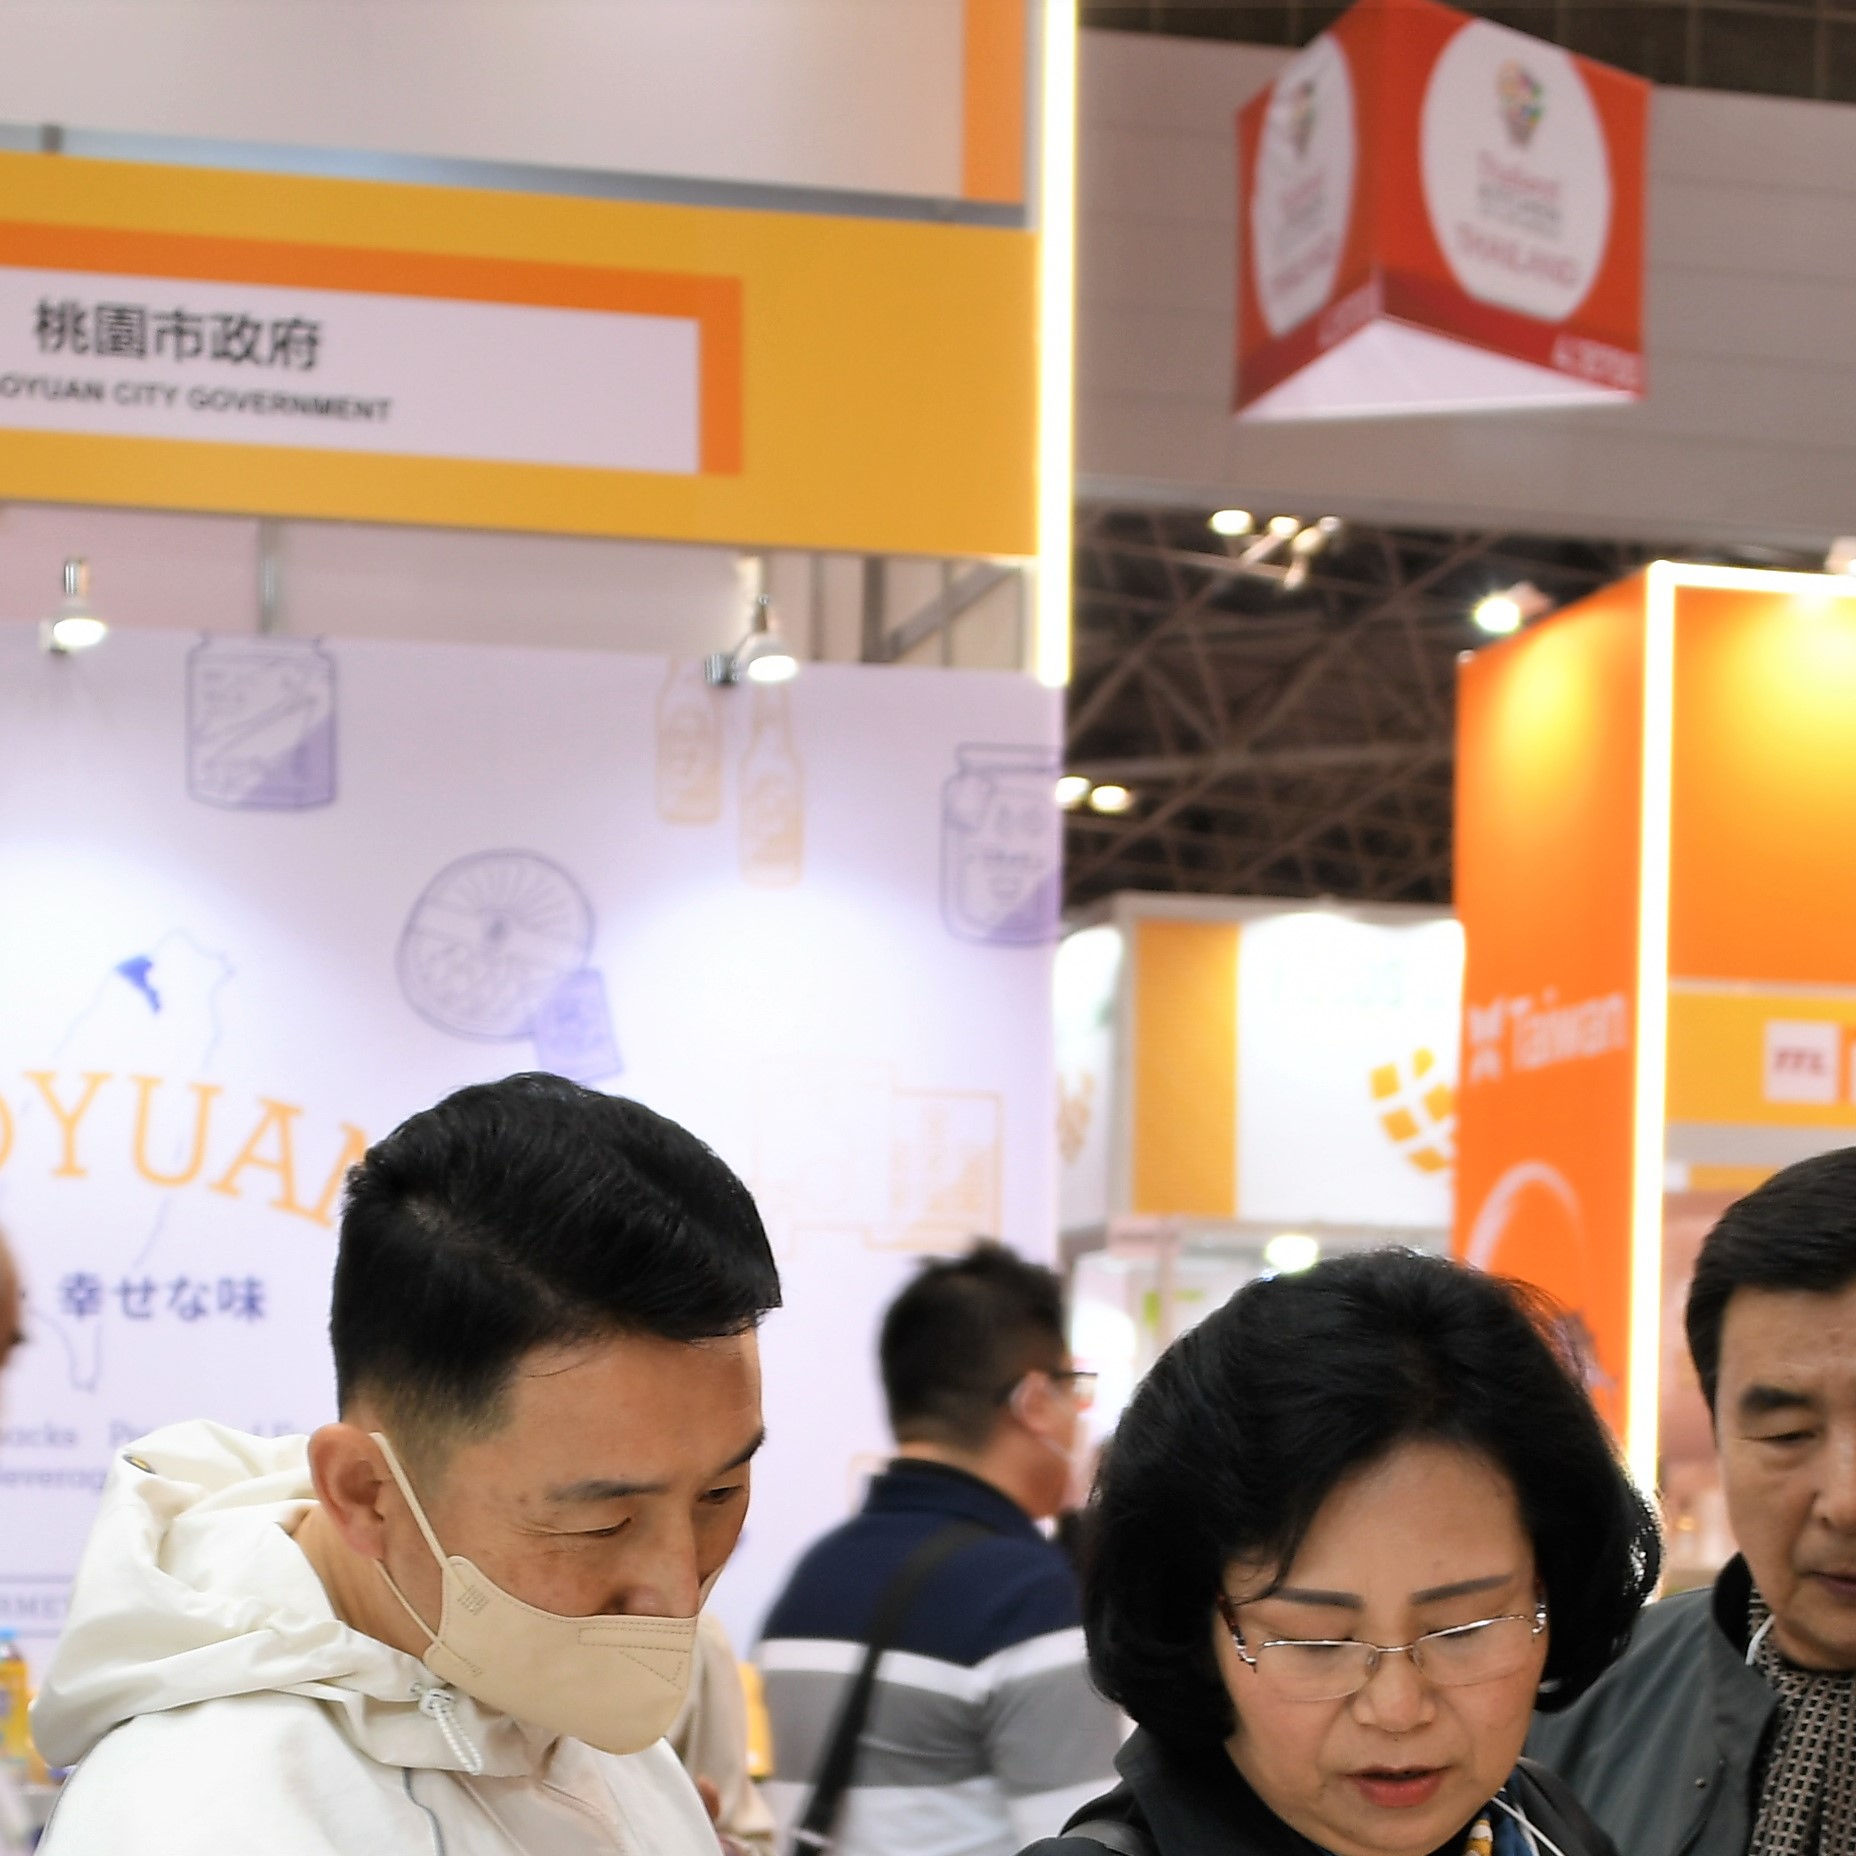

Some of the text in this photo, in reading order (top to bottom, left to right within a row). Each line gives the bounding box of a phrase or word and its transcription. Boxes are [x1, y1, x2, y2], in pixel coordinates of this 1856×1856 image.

[34, 296, 321, 370] 桃園市政府
[113, 382, 179, 408] CITY
[187, 386, 394, 423] GOVERNMENT
[1508, 986, 1628, 1073] Taiwan
[60, 1272, 267, 1321] 幸せな味
